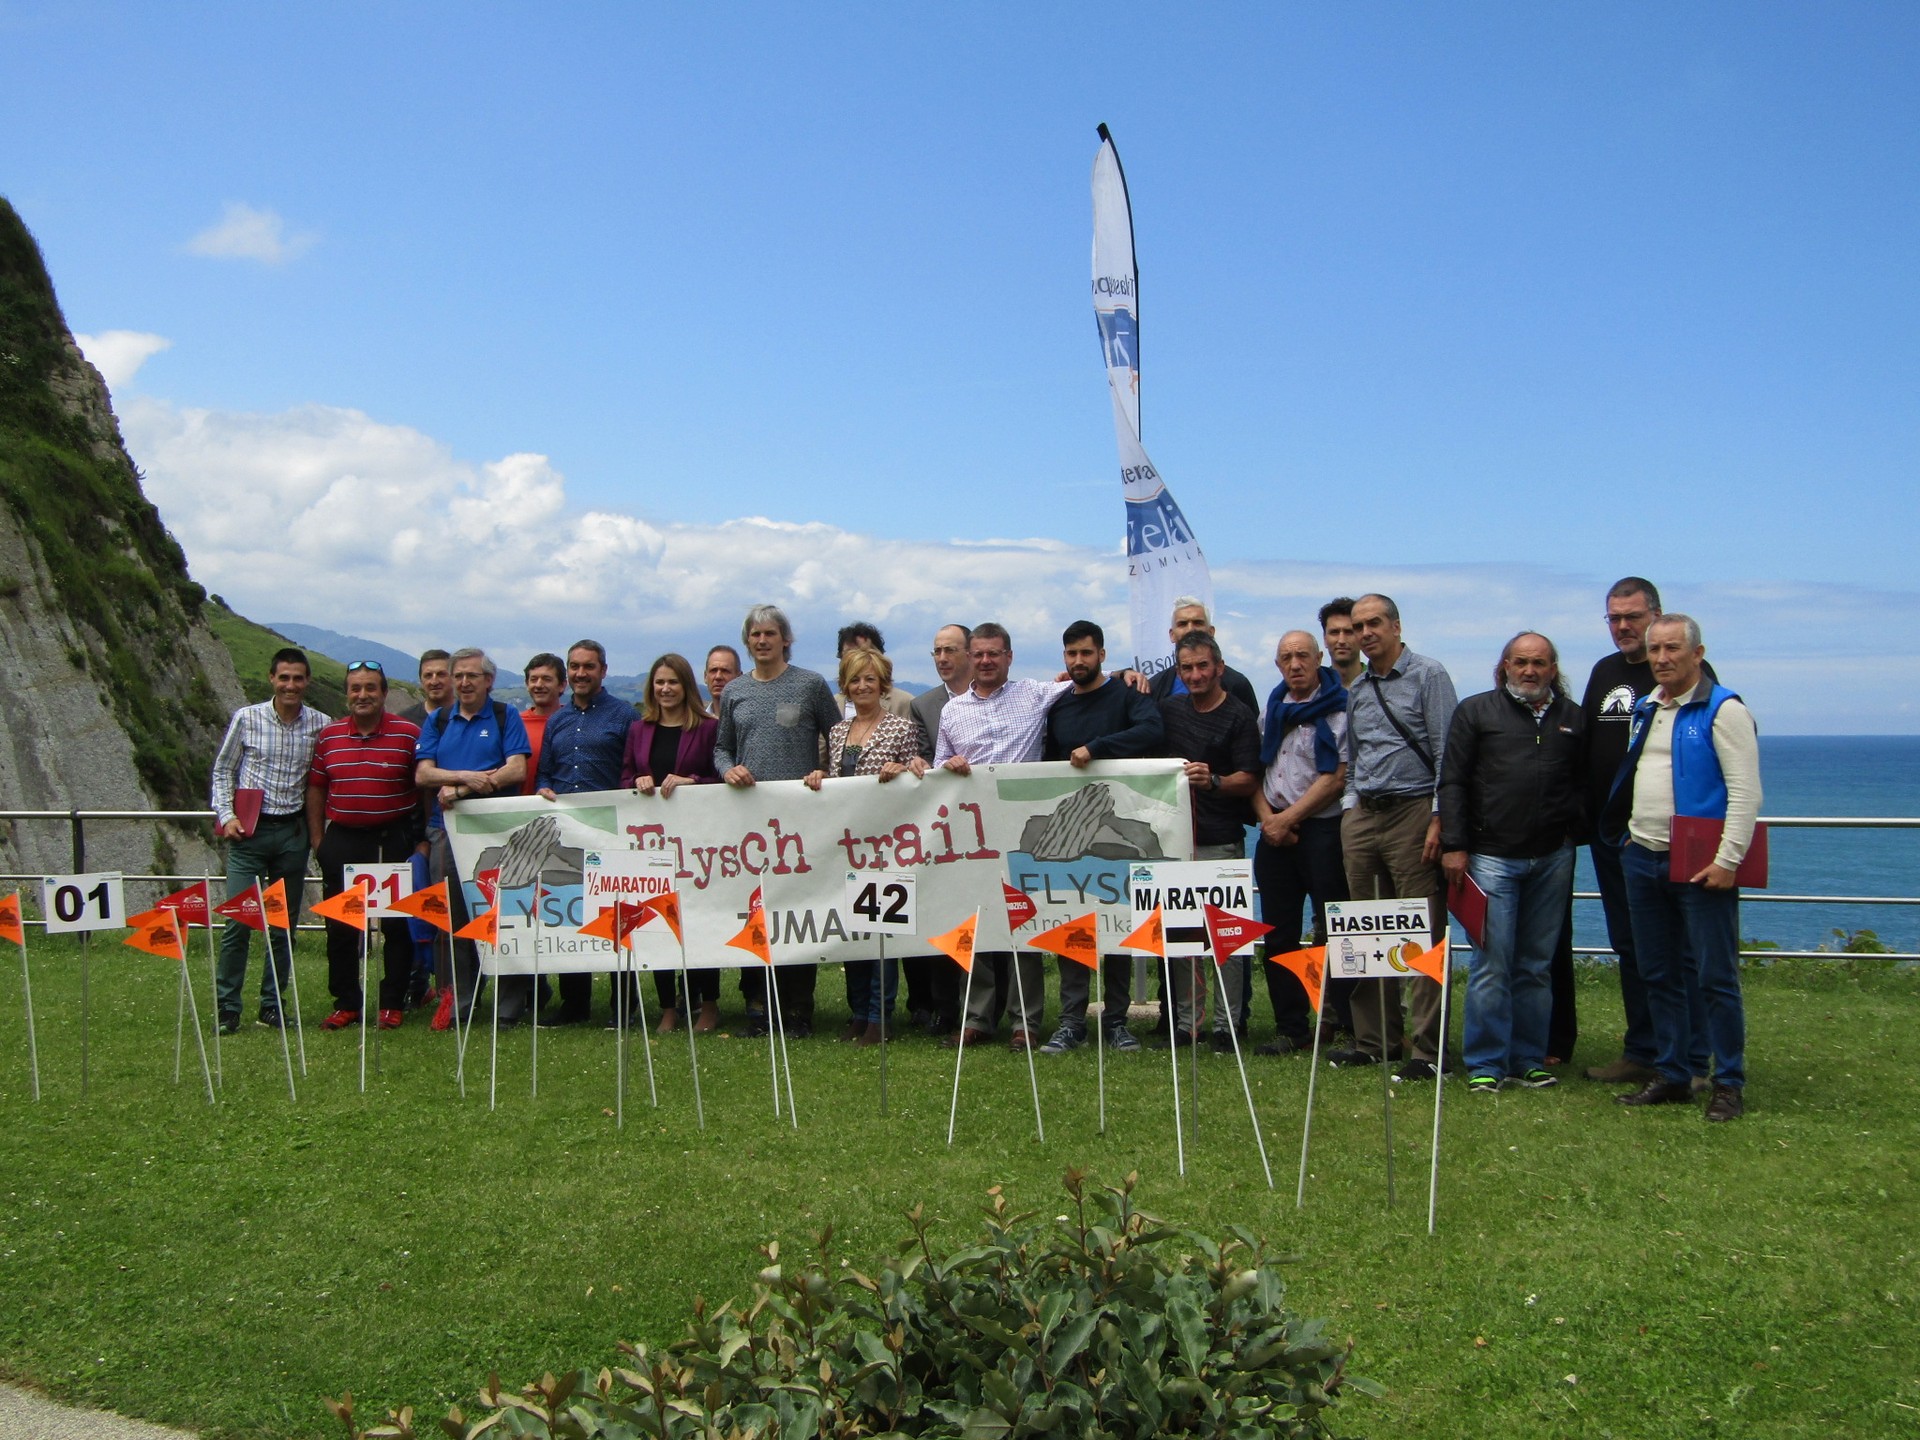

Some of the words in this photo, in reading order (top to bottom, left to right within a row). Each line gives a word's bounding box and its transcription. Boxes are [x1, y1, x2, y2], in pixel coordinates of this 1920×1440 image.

[837, 802, 1001, 870] trail
[54, 882, 111, 922] 01
[352, 873, 400, 908] 21
[600, 876, 671, 894] MARATOIA
[852, 882, 909, 924] 42
[1331, 914, 1426, 932] HASIERA
